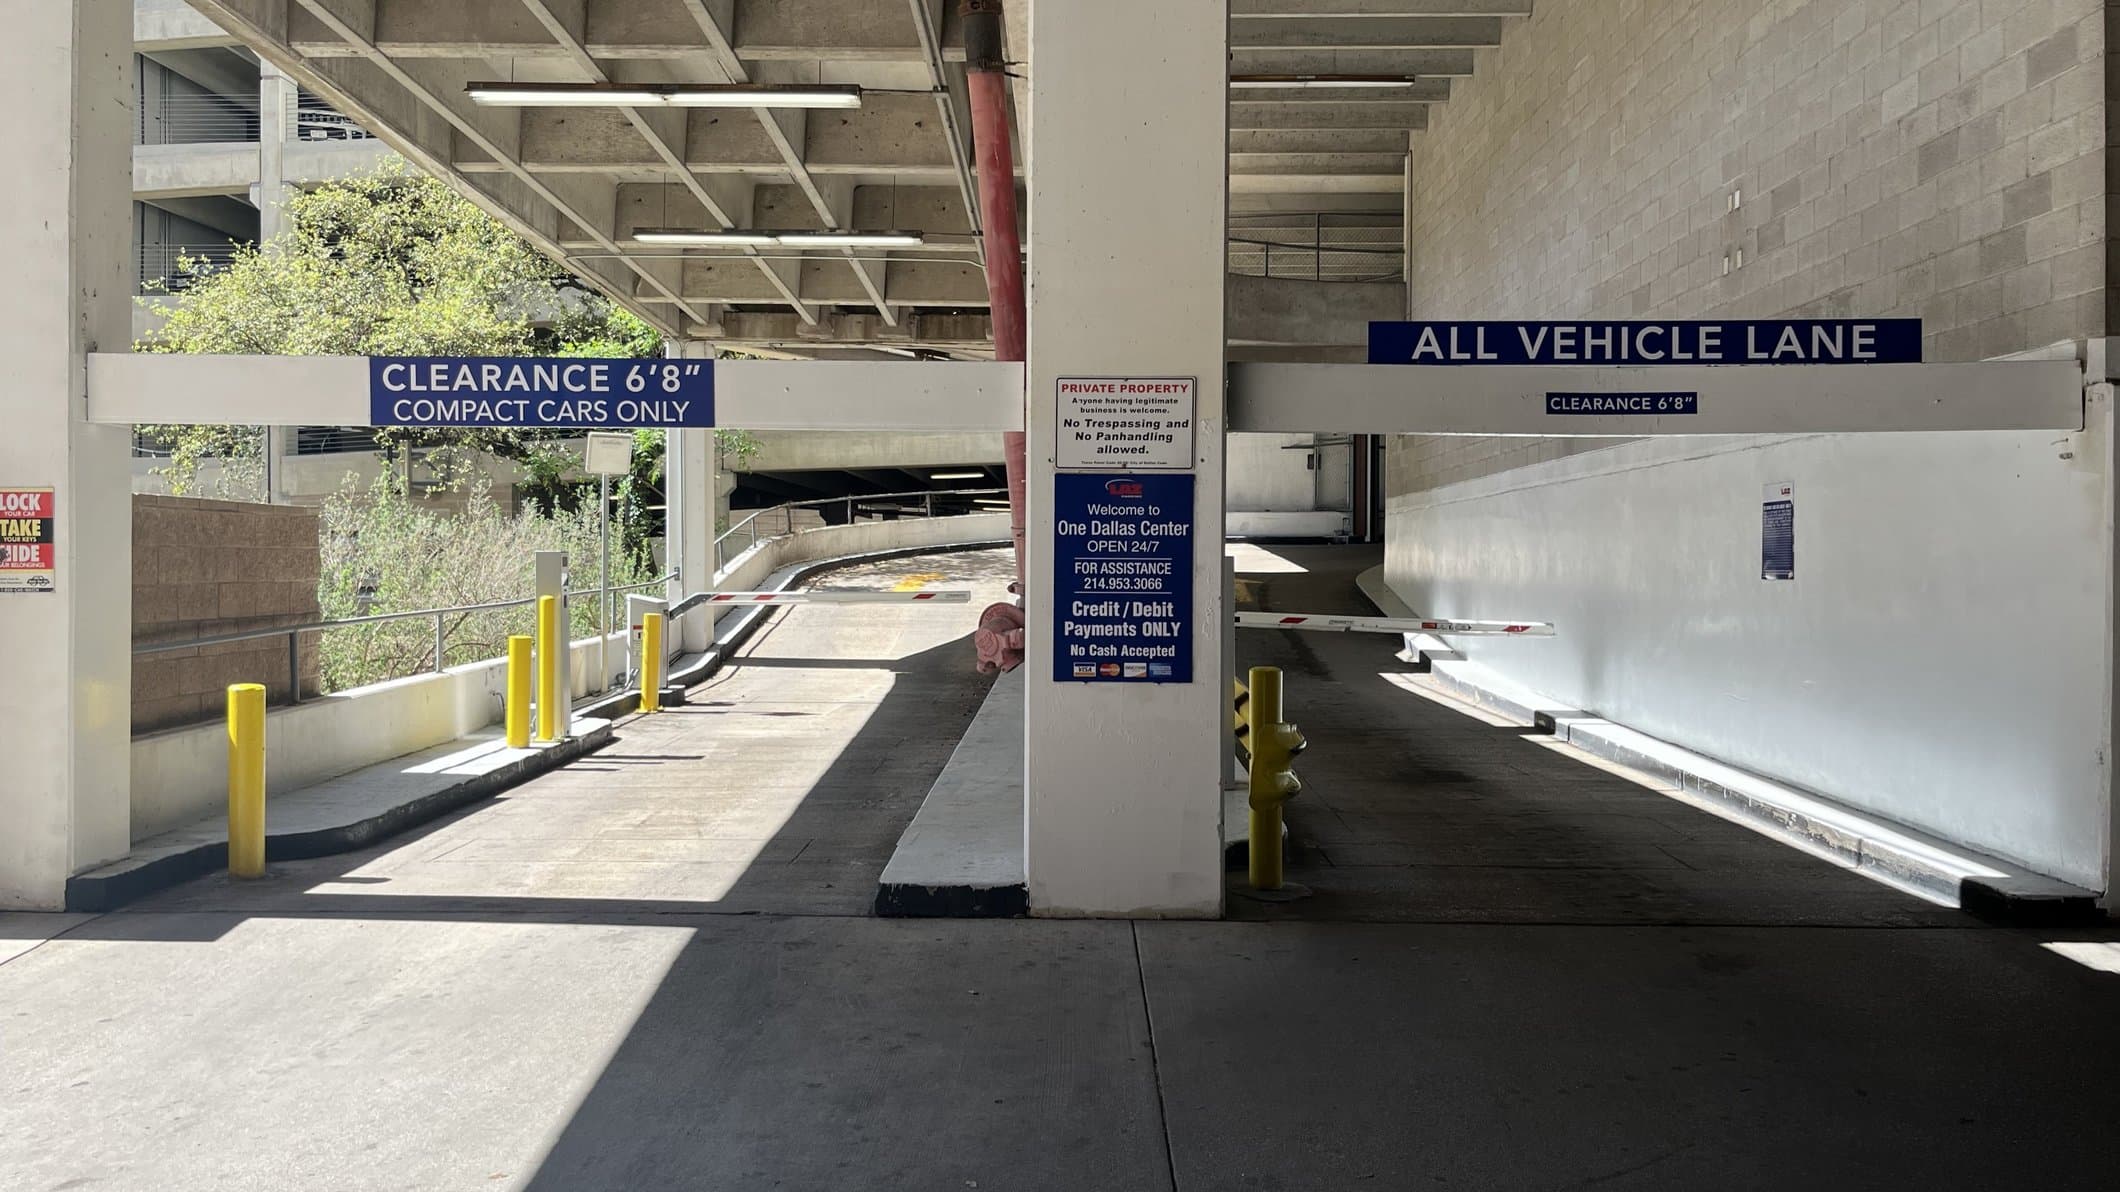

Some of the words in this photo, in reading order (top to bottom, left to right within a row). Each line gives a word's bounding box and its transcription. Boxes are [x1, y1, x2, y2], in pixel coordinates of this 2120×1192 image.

[1411, 326, 1499, 359] ALL
[1517, 326, 1723, 360] VEHICLE
[1746, 325, 1877, 360] LANE
[382, 364, 610, 392] CLEARANCE
[1061, 384, 1116, 393] PRIVATE
[1120, 384, 1189, 393] PROPERTY
[1105, 397, 1133, 405] having
[1135, 397, 1179, 405] legitimate
[1550, 397, 1651, 410] CLEARANCE
[393, 400, 530, 422] COMPACT
[537, 400, 608, 422] CARS
[616, 401, 690, 423] ONLY
[1063, 419, 1080, 428] No
[1085, 419, 1161, 430] Trespassing
[1166, 419, 1190, 428] and
[1075, 432, 1092, 441] No
[1096, 432, 1174, 443] Panhandling
[1096, 445, 1150, 454] allowed.
[0, 493, 41, 511] LOCK
[1087, 504, 1145, 515] Welcome
[1148, 505, 1161, 515] to
[0, 519, 41, 537] TAKE
[1058, 520, 1087, 535] One
[1091, 520, 1136, 535] Dallas
[1140, 520, 1189, 536] Center
[1087, 540, 1128, 552] OPEN
[1131, 541, 1160, 552] 24/7
[1074, 562, 1098, 574] FOR
[1100, 562, 1172, 575] ASSISTANCE
[1084, 578, 1162, 590] 214.953.3066
[1072, 601, 1120, 617] Credit
[1133, 602, 1174, 617] Debit
[1064, 621, 1137, 639] Payments
[1142, 621, 1181, 637] ONLY
[1070, 644, 1086, 657] No
[1089, 644, 1117, 657] Cash
[1121, 644, 1175, 659] Accepted
